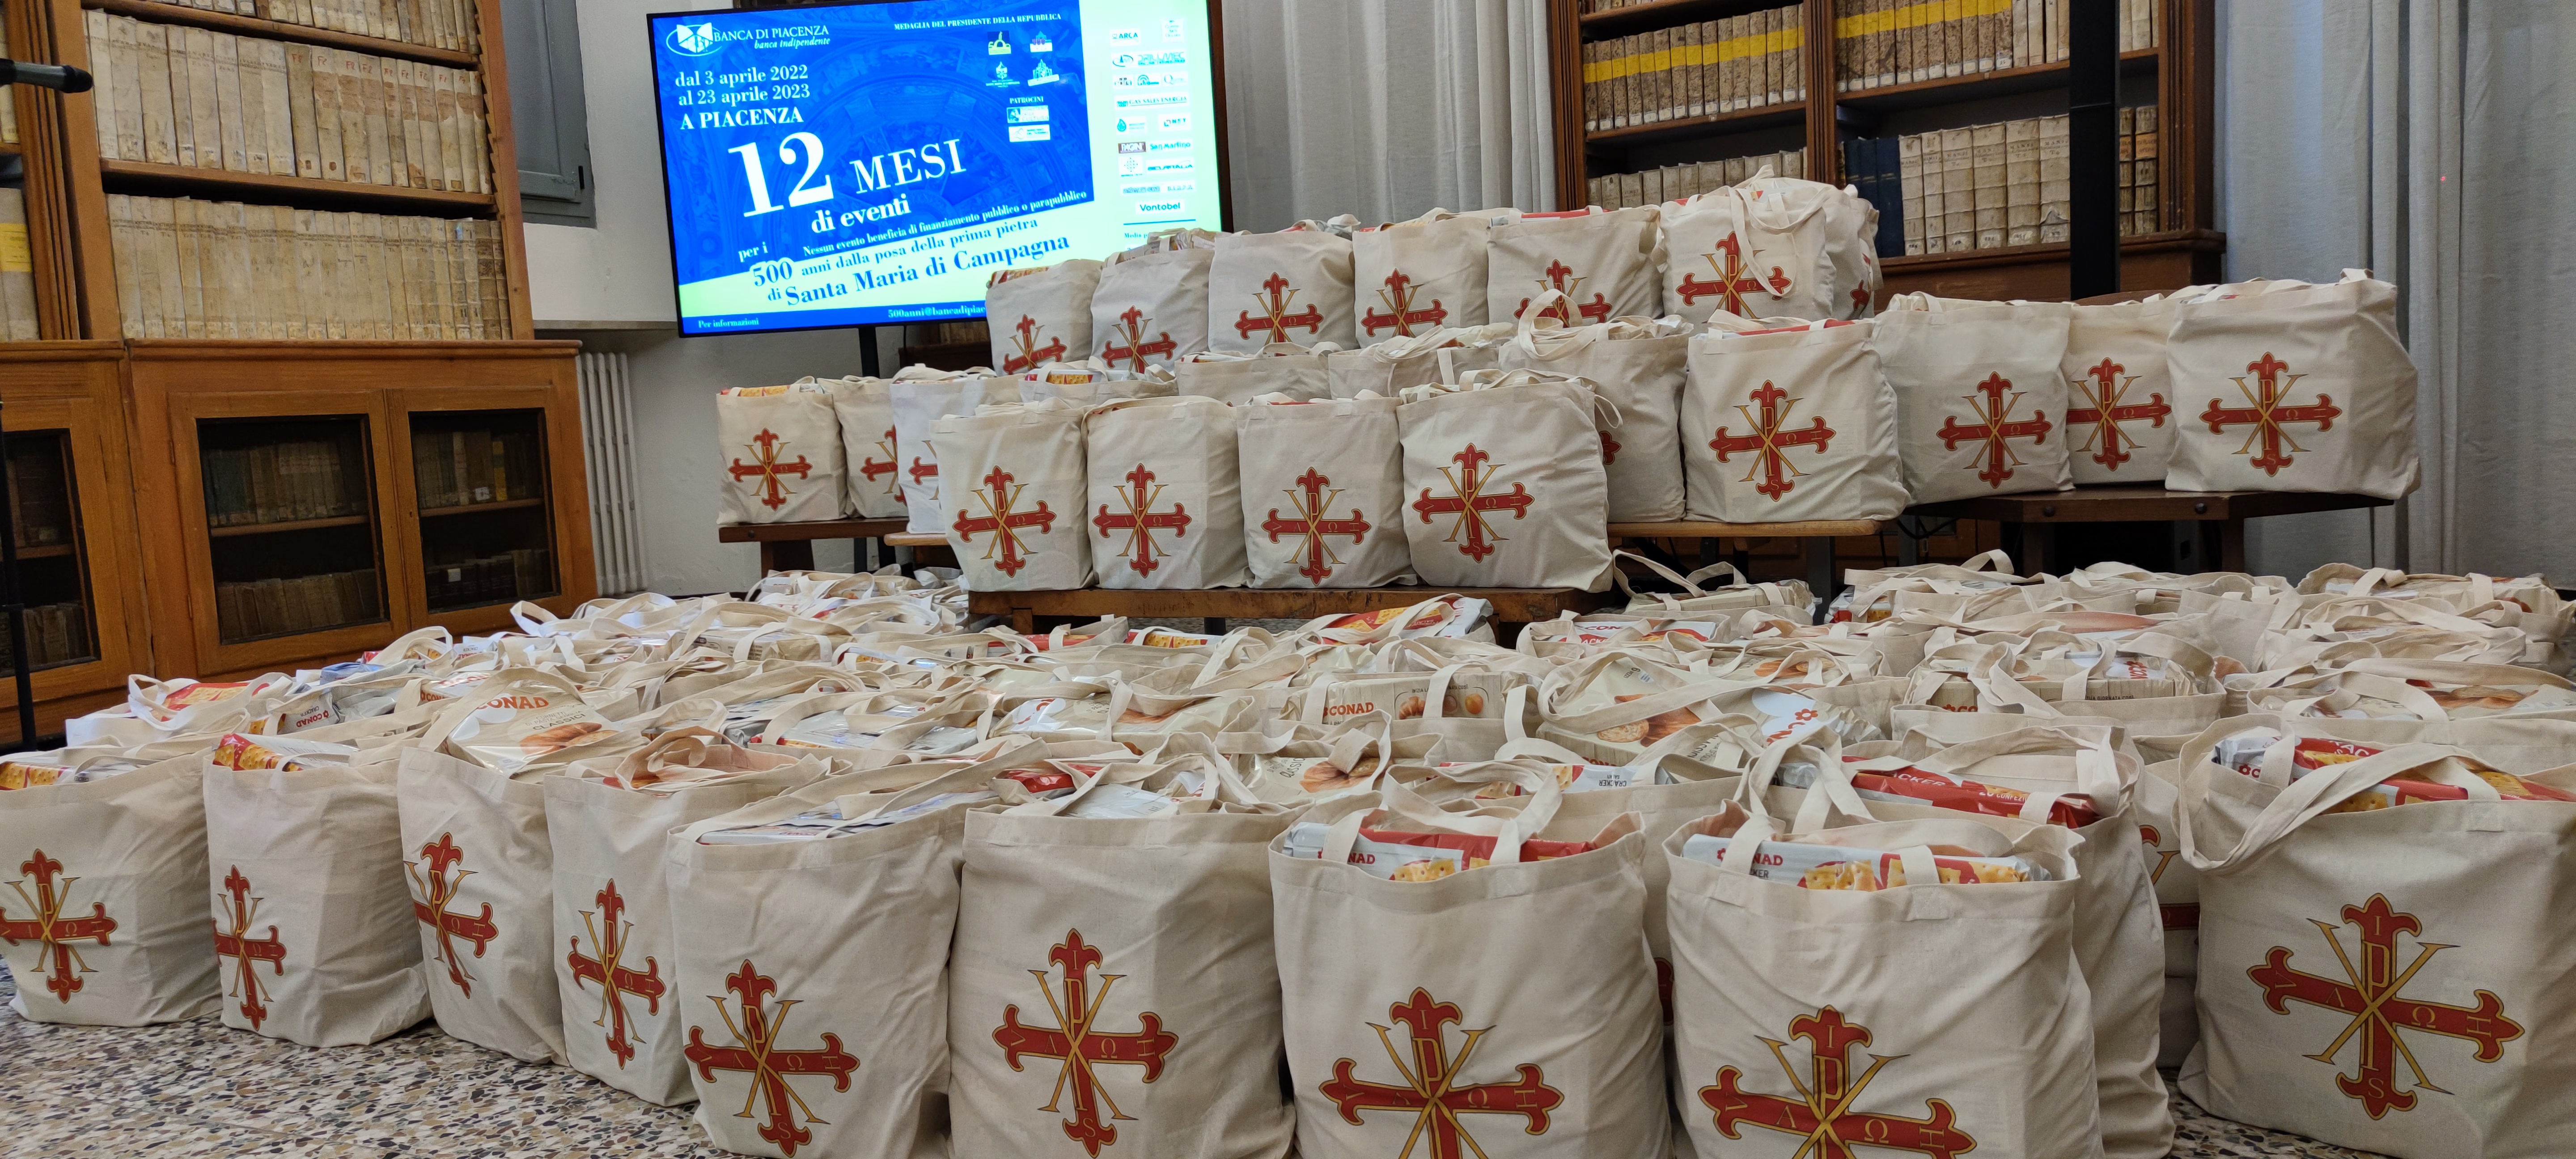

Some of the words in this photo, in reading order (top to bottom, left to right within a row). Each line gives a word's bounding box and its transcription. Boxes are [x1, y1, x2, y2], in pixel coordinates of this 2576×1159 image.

[894, 22, 930, 30] MEDAGLIA
[947, 18, 991, 27] PRESIDENTE
[1017, 13, 1062, 22] REPUBBLICA
[713, 30, 754, 42] BANCA
[756, 29, 769, 39] DI
[772, 25, 829, 38] PIACENZA
[754, 40, 777, 49] banca
[780, 36, 830, 49] indipendente
[675, 70, 700, 87] dal
[705, 71, 714, 85] 3
[719, 67, 766, 88] aprile
[770, 64, 809, 81] 2022
[678, 90, 694, 106] al
[697, 89, 716, 104] 23
[721, 86, 768, 107] aprile
[772, 83, 810, 100] 2023
[1009, 96, 1044, 104] PATROCINI
[680, 113, 695, 130] A
[699, 106, 804, 129] PIACENZA
[728, 131, 834, 217] 12
[849, 139, 967, 194] MESI
[811, 209, 836, 233] di
[840, 193, 912, 227] eventi
[1140, 202, 1181, 211] Vontobel
[803, 243, 835, 257] Nessun
[836, 237, 866, 251] evento
[866, 227, 907, 246] beneficia
[908, 224, 918, 235] di
[919, 213, 980, 233] finanziamento
[982, 204, 1020, 222] pubblico
[1021, 203, 1028, 211] o
[1030, 190, 1087, 212] parapubblico
[738, 246, 759, 263] per
[762, 241, 768, 254] i
[753, 261, 793, 287] 500
[801, 259, 832, 276] anni
[836, 253, 869, 269] dalla
[875, 247, 907, 263] posa
[911, 237, 945, 254] della
[950, 229, 992, 248] prima
[996, 219, 1038, 238] pietra
[768, 288, 782, 301] di
[785, 282, 848, 307] Santa
[853, 265, 919, 292] Maria
[925, 257, 948, 277] di
[953, 236, 1070, 271] Campagna
[699, 319, 712, 329] Per
[713, 317, 759, 327] informazioni
[1329, 702, 1374, 716] CONAD
[296, 713, 322, 728] CONAD
[532, 713, 586, 731] CLASSICI
[1348, 852, 1376, 864] NAD
[1753, 852, 1783, 866] NAD
